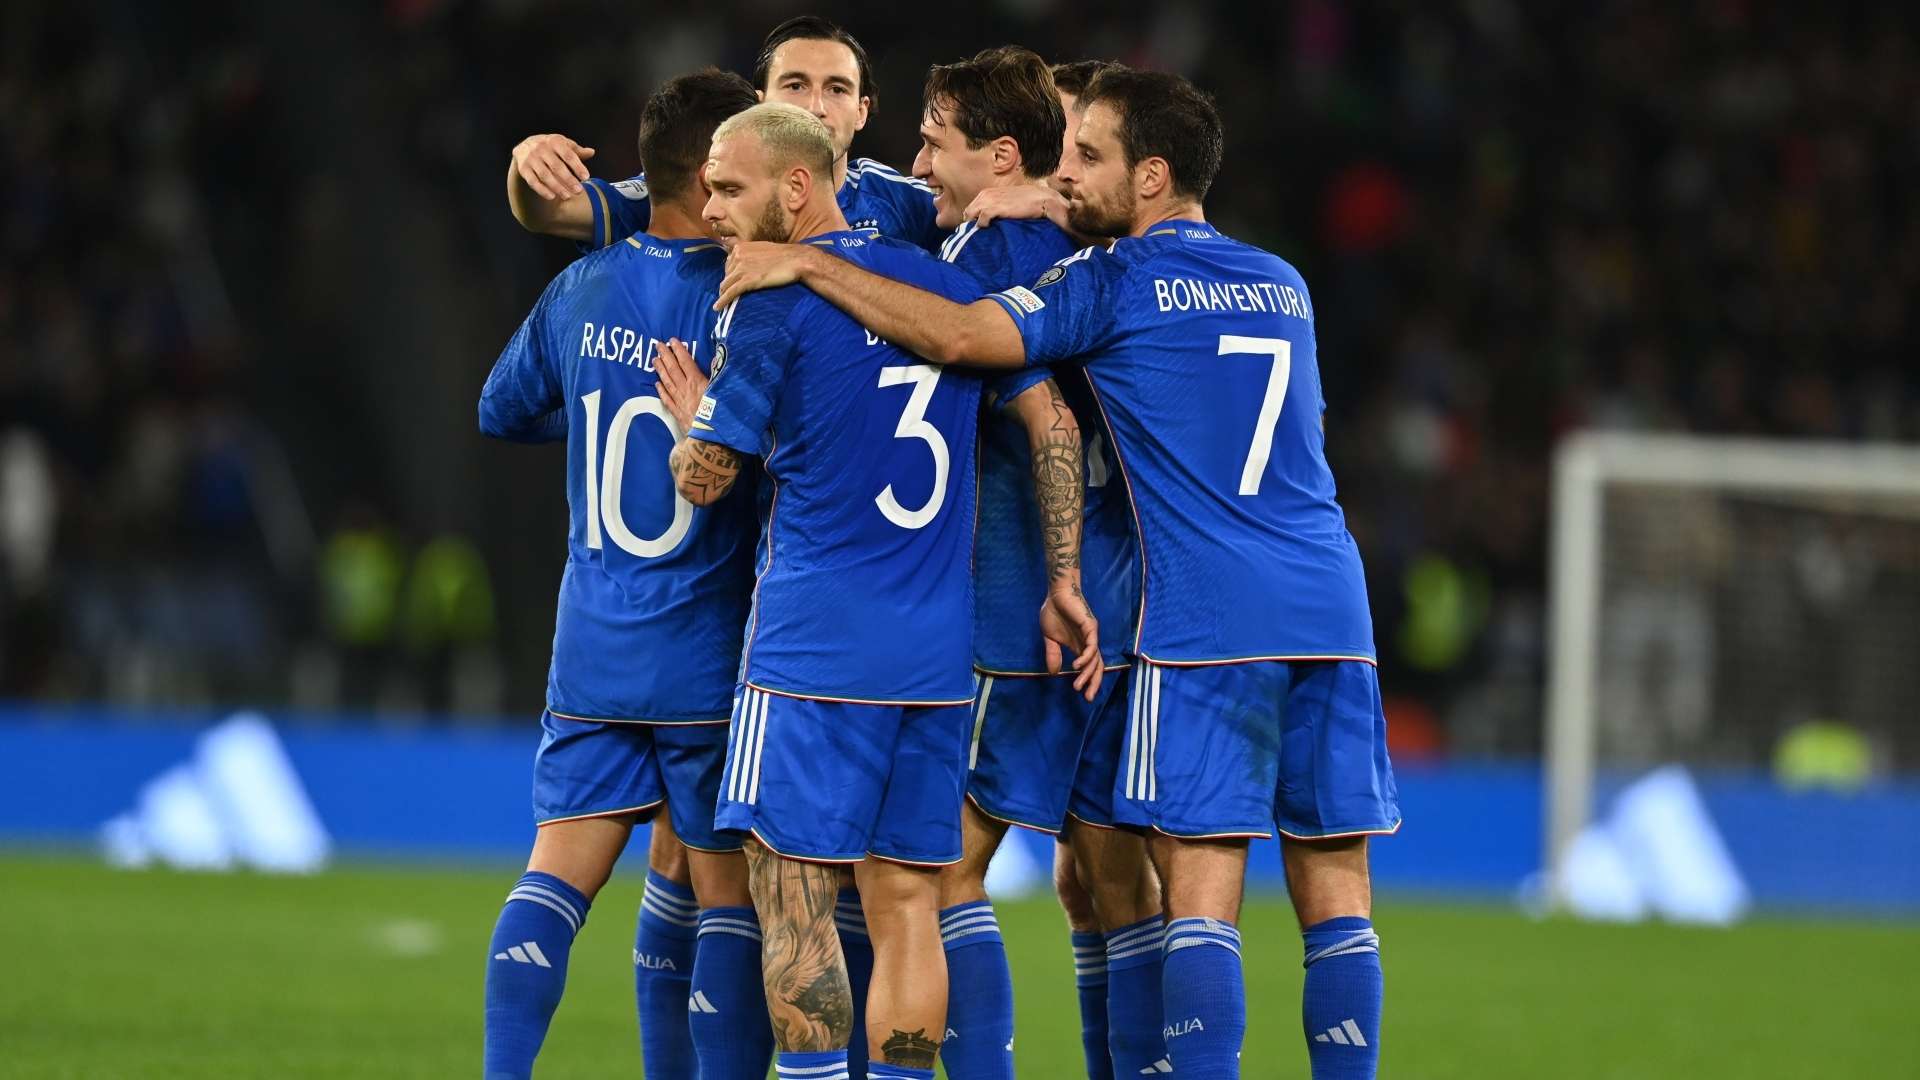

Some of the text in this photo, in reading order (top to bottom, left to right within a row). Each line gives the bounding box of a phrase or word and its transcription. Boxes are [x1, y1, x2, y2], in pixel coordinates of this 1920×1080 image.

[645, 246, 672, 258] ITALIA
[1185, 229, 1213, 239] ITALIA
[1154, 279, 1311, 322] BONAVENTURA
[580, 322, 697, 373] RASPADI
[1217, 335, 1291, 496] 7
[875, 364, 950, 529] 3
[581, 389, 695, 558] 10
